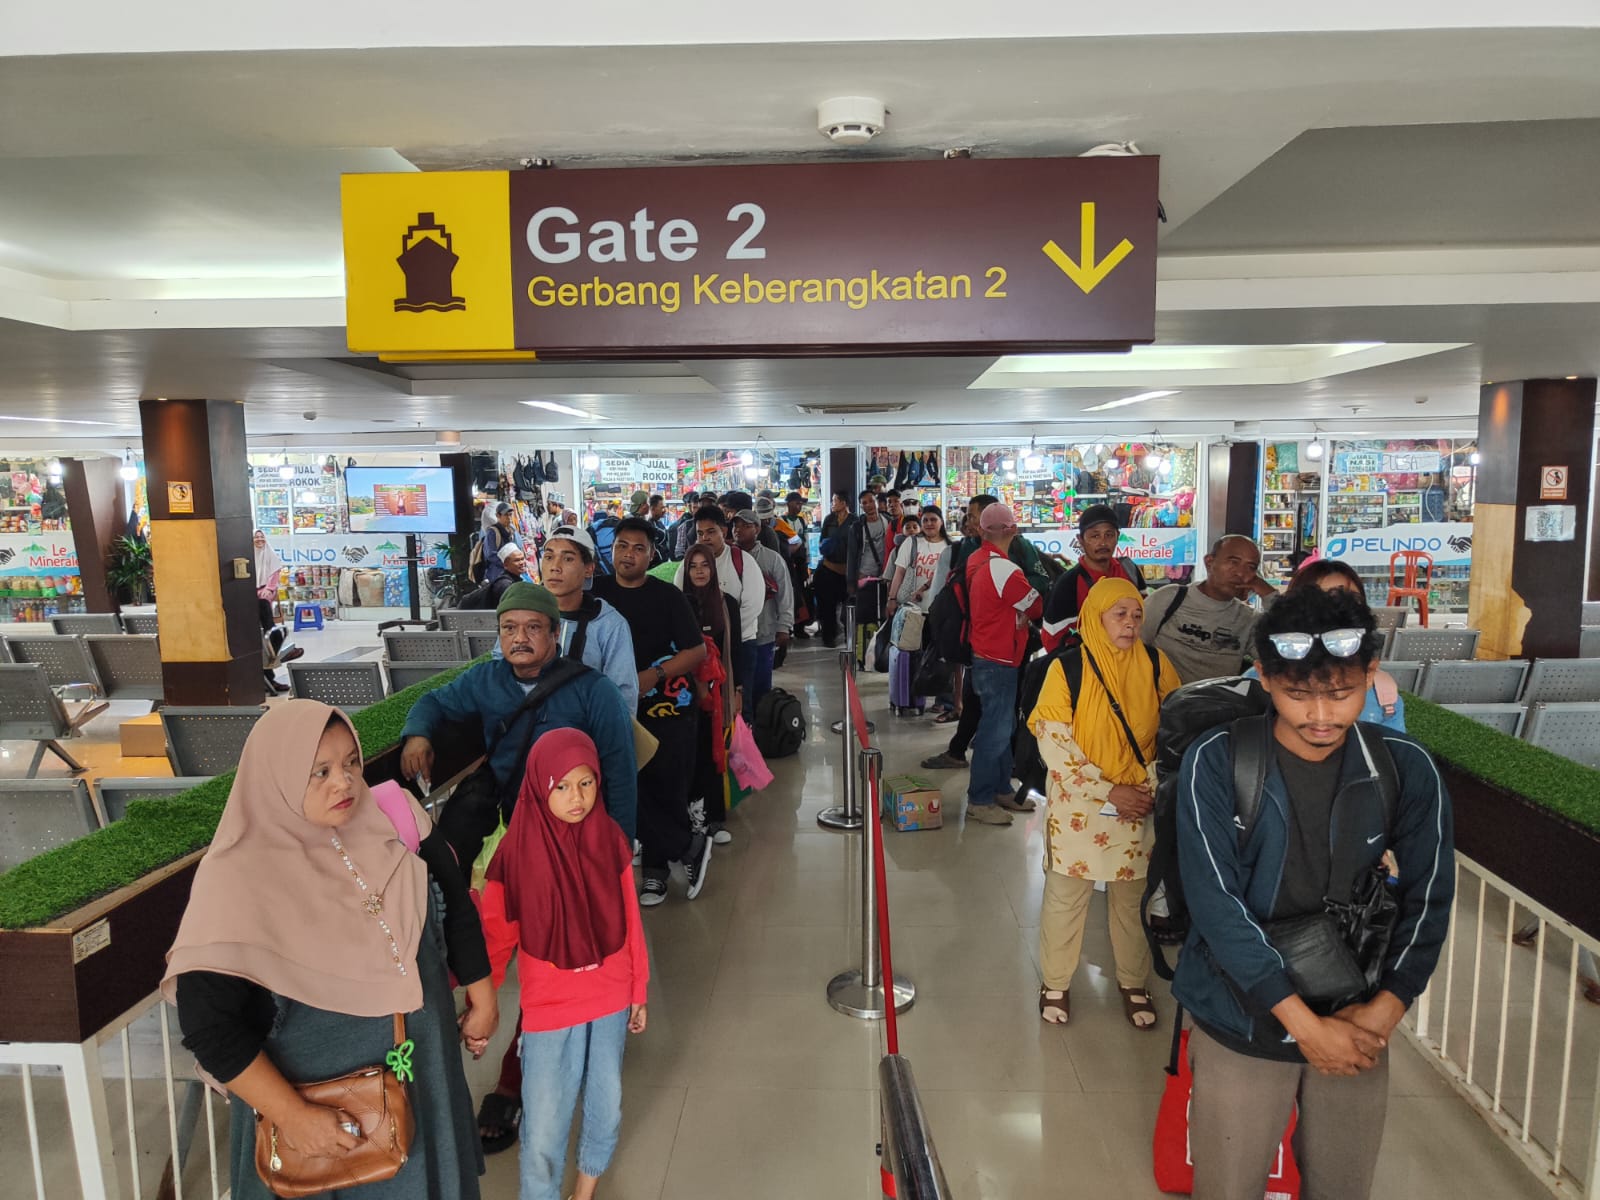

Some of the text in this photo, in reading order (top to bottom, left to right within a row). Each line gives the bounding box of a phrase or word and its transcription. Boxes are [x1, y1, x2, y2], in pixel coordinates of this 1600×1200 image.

[526, 203, 766, 263] Gate 2
[527, 267, 1007, 313] Gerbang Keberangkatan 2
[647, 460, 670, 468] JUAL
[289, 478, 321, 487] ROKOK
[643, 472, 674, 481] ROKOK
[1141, 534, 1157, 547] Le
[1351, 537, 1442, 552] PELINDO
[52, 543, 67, 557] Le
[1116, 545, 1172, 558] Minerale
[1178, 623, 1211, 641] Jeep
